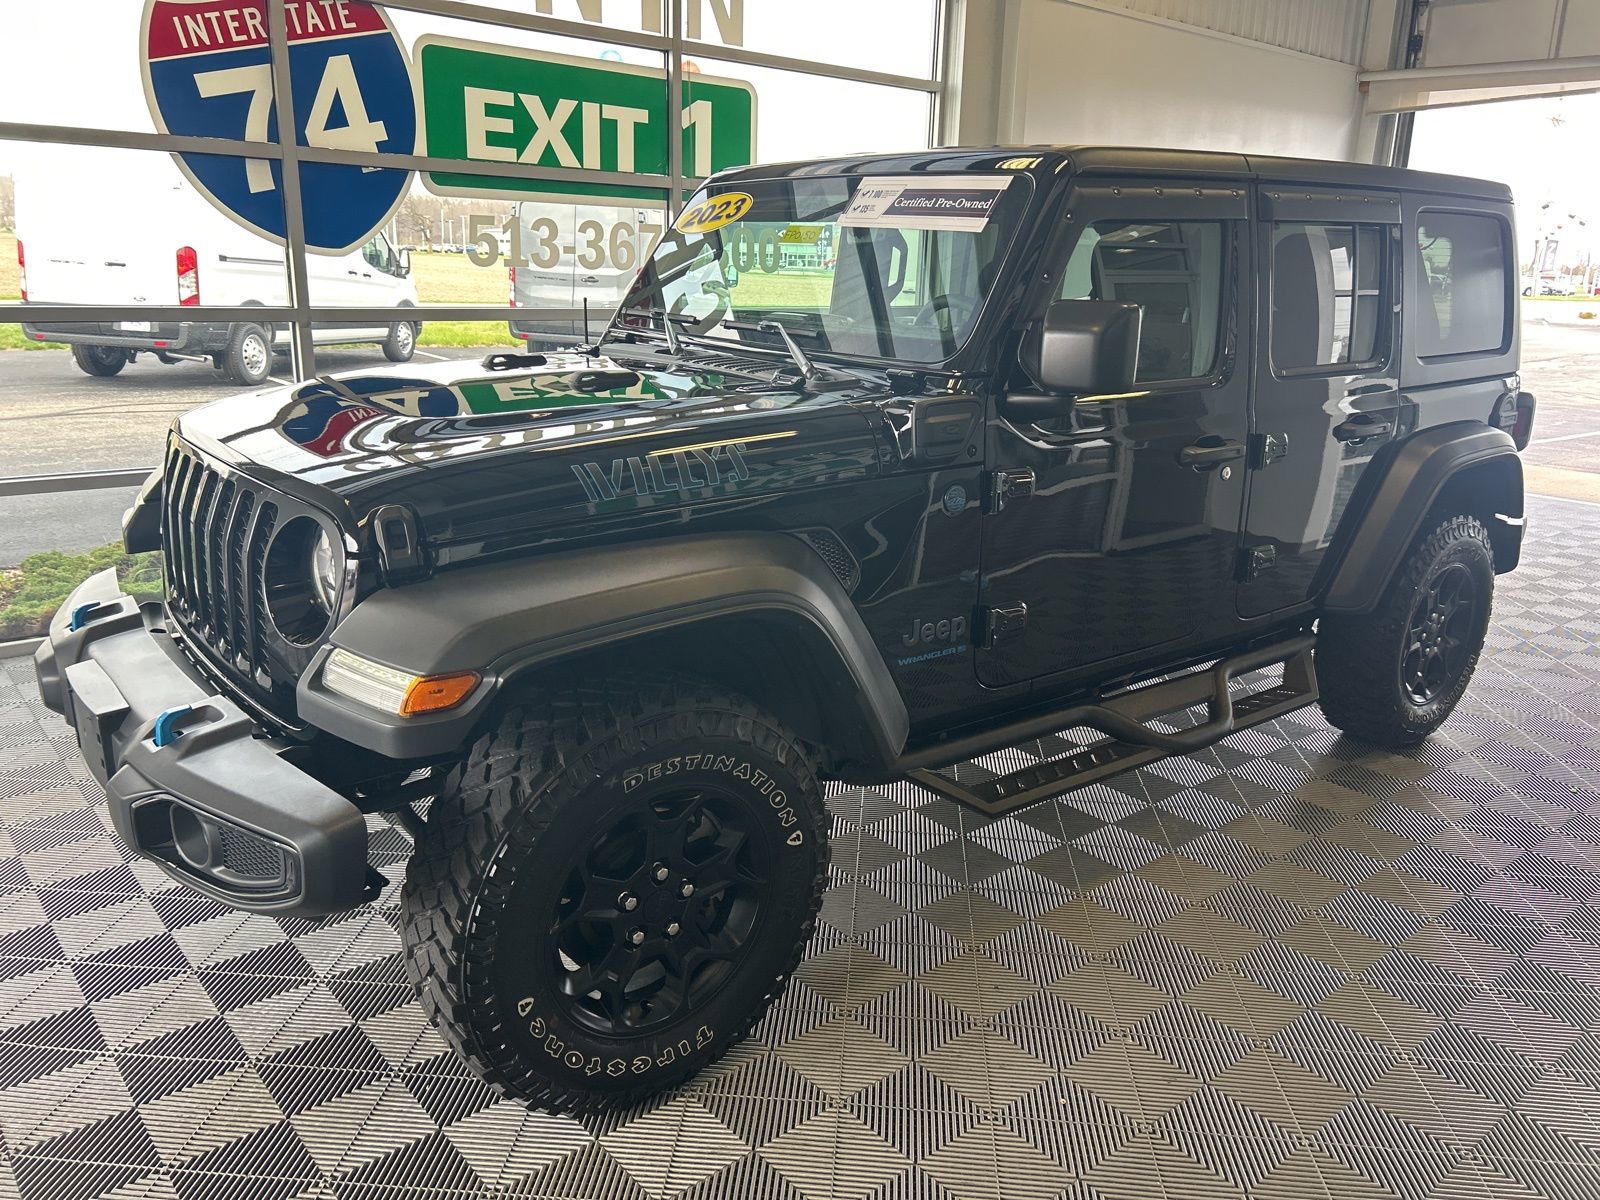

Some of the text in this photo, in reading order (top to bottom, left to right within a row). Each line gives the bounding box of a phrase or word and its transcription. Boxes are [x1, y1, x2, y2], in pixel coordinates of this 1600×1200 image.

[172, 0, 357, 49] INTERTATE
[193, 54, 389, 193] 74
[464, 86, 712, 178] EXIT 1
[683, 197, 747, 228] 2023
[894, 197, 993, 209] Certified Pre-Owned
[570, 443, 749, 501] WILLYS
[897, 647, 956, 666] WRANGLER
[902, 616, 966, 647] Jeep
[623, 754, 797, 828] DESTINATION
[530, 1018, 714, 1077] Firestone
